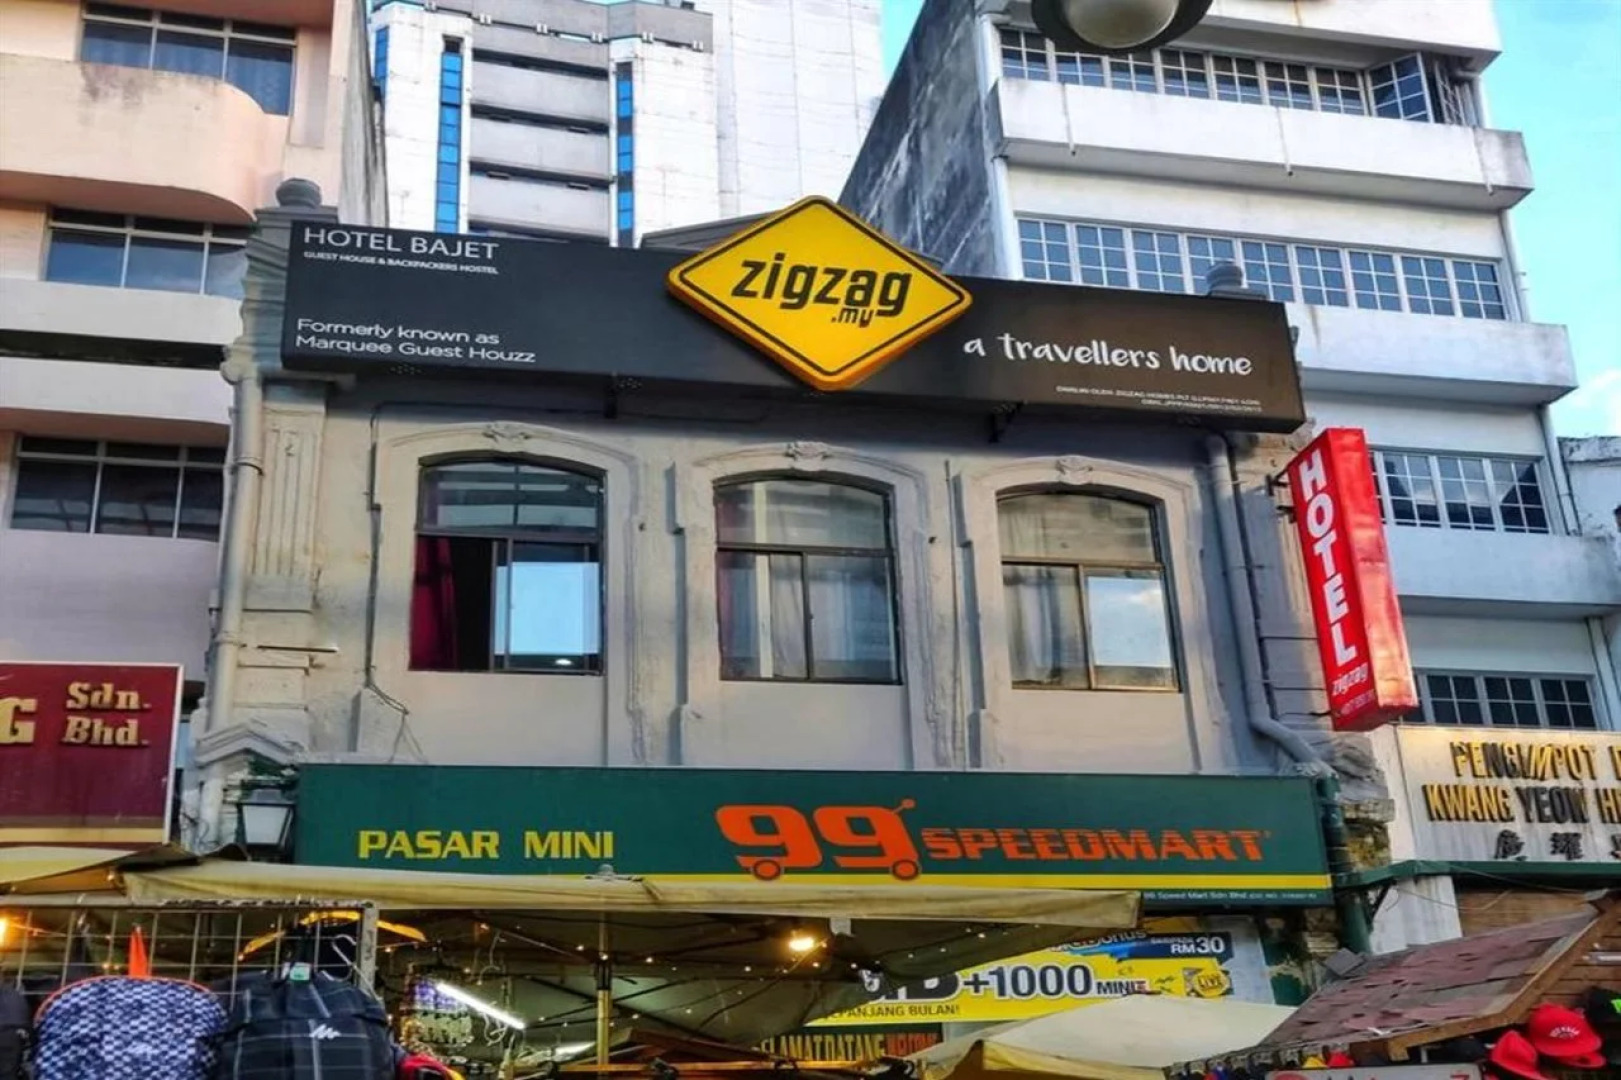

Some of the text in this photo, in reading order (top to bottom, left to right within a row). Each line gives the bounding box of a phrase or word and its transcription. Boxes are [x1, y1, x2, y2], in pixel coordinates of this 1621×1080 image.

[304, 227, 499, 258] HOTEL BAJET
[304, 251, 338, 260] GUEST
[339, 254, 376, 265] HOUSE
[387, 258, 458, 271] BACKPACKERS
[460, 264, 499, 274] HOSTEL
[731, 252, 912, 317] zigzag
[297, 318, 500, 345] Formerly known as
[831, 307, 874, 327] .my
[296, 335, 536, 363] Marquee Guest Houzz
[963, 333, 1254, 376] a travellers home
[1299, 449, 1357, 667] HOTEL
[66, 682, 151, 710] Sdn.
[62, 715, 150, 745] Bhd.
[1422, 784, 1515, 822] KWANG
[1516, 786, 1590, 824] YEOW
[358, 830, 614, 859] PASAR MINI
[715, 799, 1265, 881] 99 SPEEDMART
[909, 1003, 959, 1016] BULAN!
